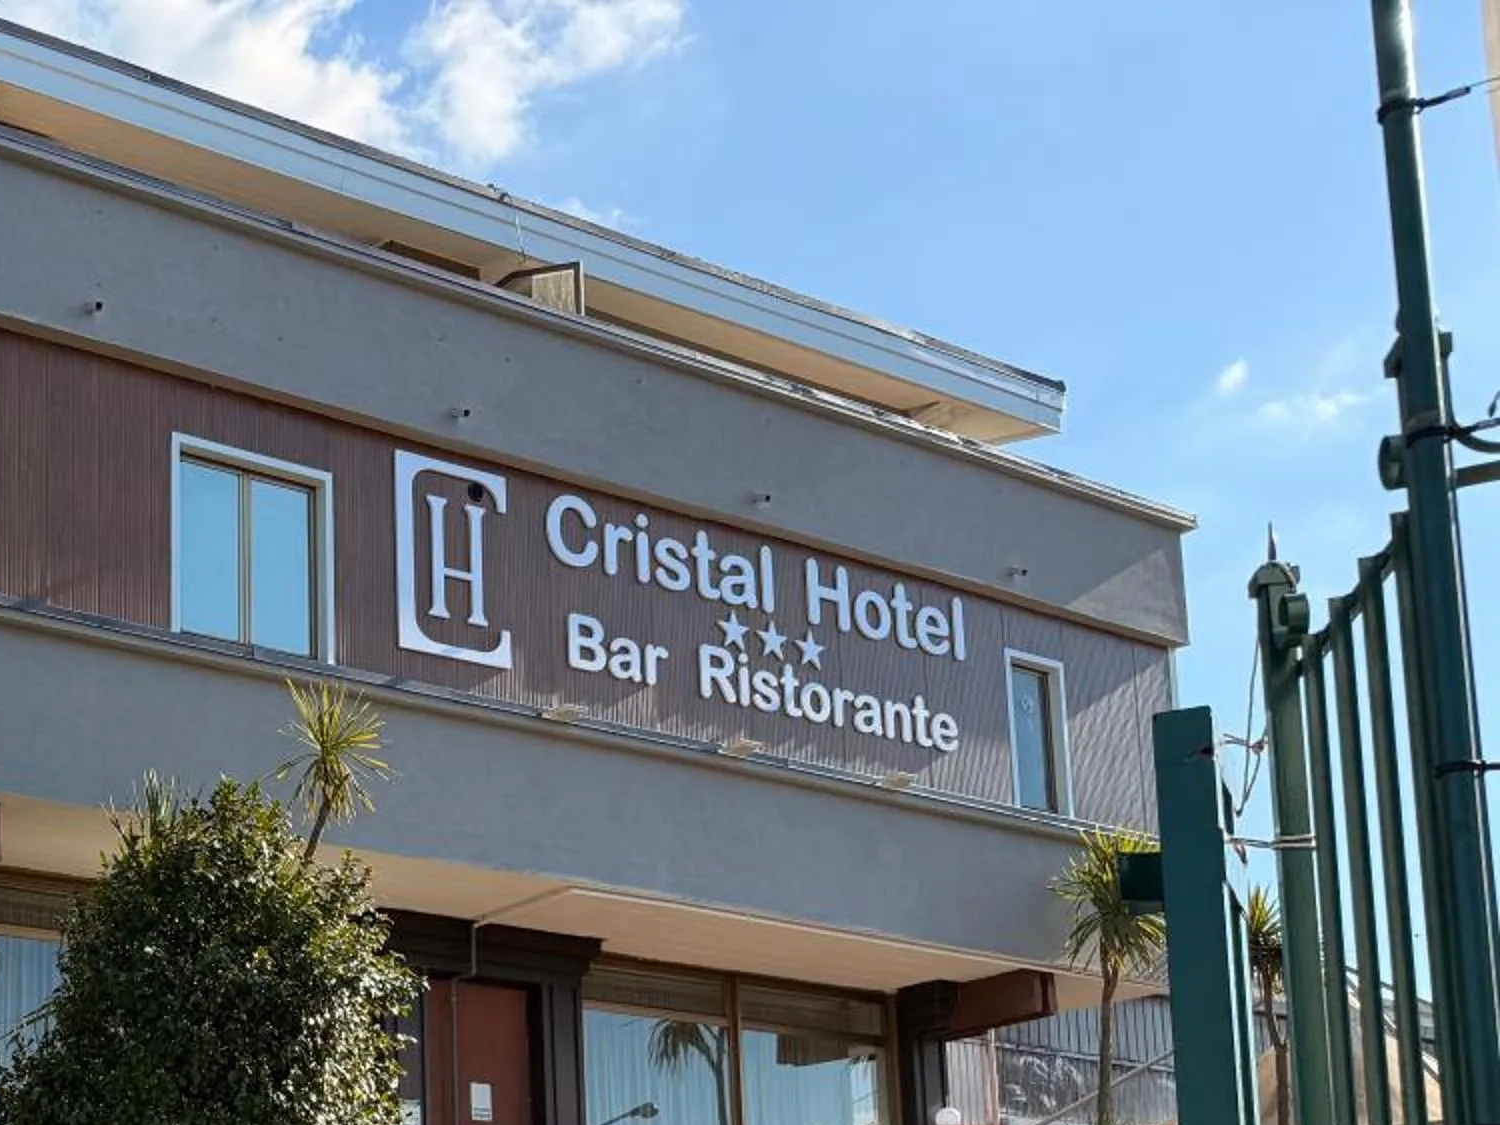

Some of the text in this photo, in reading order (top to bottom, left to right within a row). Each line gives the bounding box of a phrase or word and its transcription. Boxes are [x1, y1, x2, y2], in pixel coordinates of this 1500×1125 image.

[545, 495, 966, 661] Cristal Hotel
[566, 613, 959, 752] Bar Ristorante
